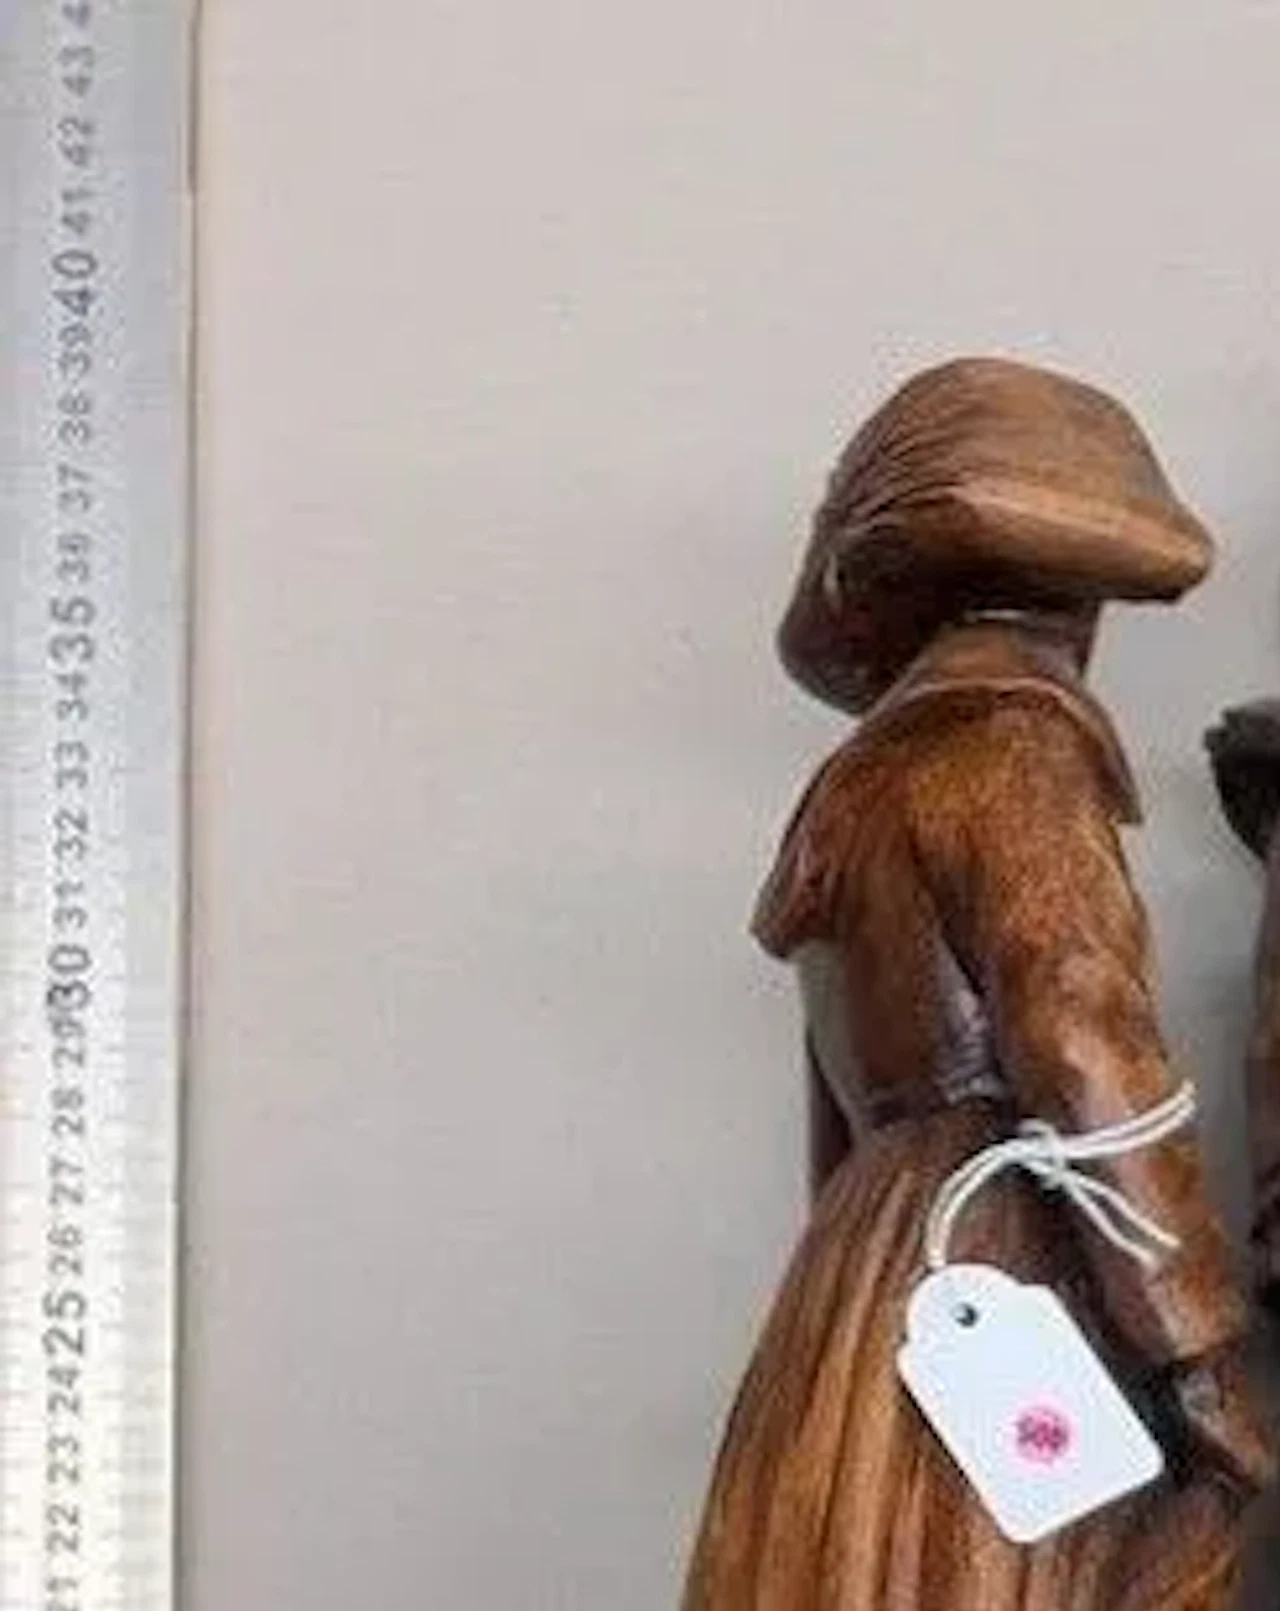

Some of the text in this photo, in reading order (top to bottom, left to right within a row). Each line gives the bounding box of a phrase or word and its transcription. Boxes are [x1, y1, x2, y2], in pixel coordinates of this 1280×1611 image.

[59, 47, 95, 95] 43
[59, 117, 95, 166] 42
[59, 189, 94, 234] 41
[52, 249, 98, 316] 40
[59, 323, 92, 372] 39
[58, 398, 92, 441] 38
[58, 464, 91, 510] 37
[58, 533, 90, 580] 36
[49, 597, 95, 660] 35
[57, 672, 89, 719] 34
[55, 741, 89, 789] 33
[53, 809, 88, 859] 32
[53, 881, 88, 927] 31
[45, 943, 92, 1013] 30
[52, 1018, 87, 1067] 29
[50, 1087, 86, 1136] 28
[48, 1156, 84, 1206] 27
[46, 1225, 83, 1275] 26
[41, 1290, 88, 1356] 25
[46, 1365, 81, 1414] 24
[45, 1434, 81, 1484] 23
[44, 1503, 80, 1554] 22
